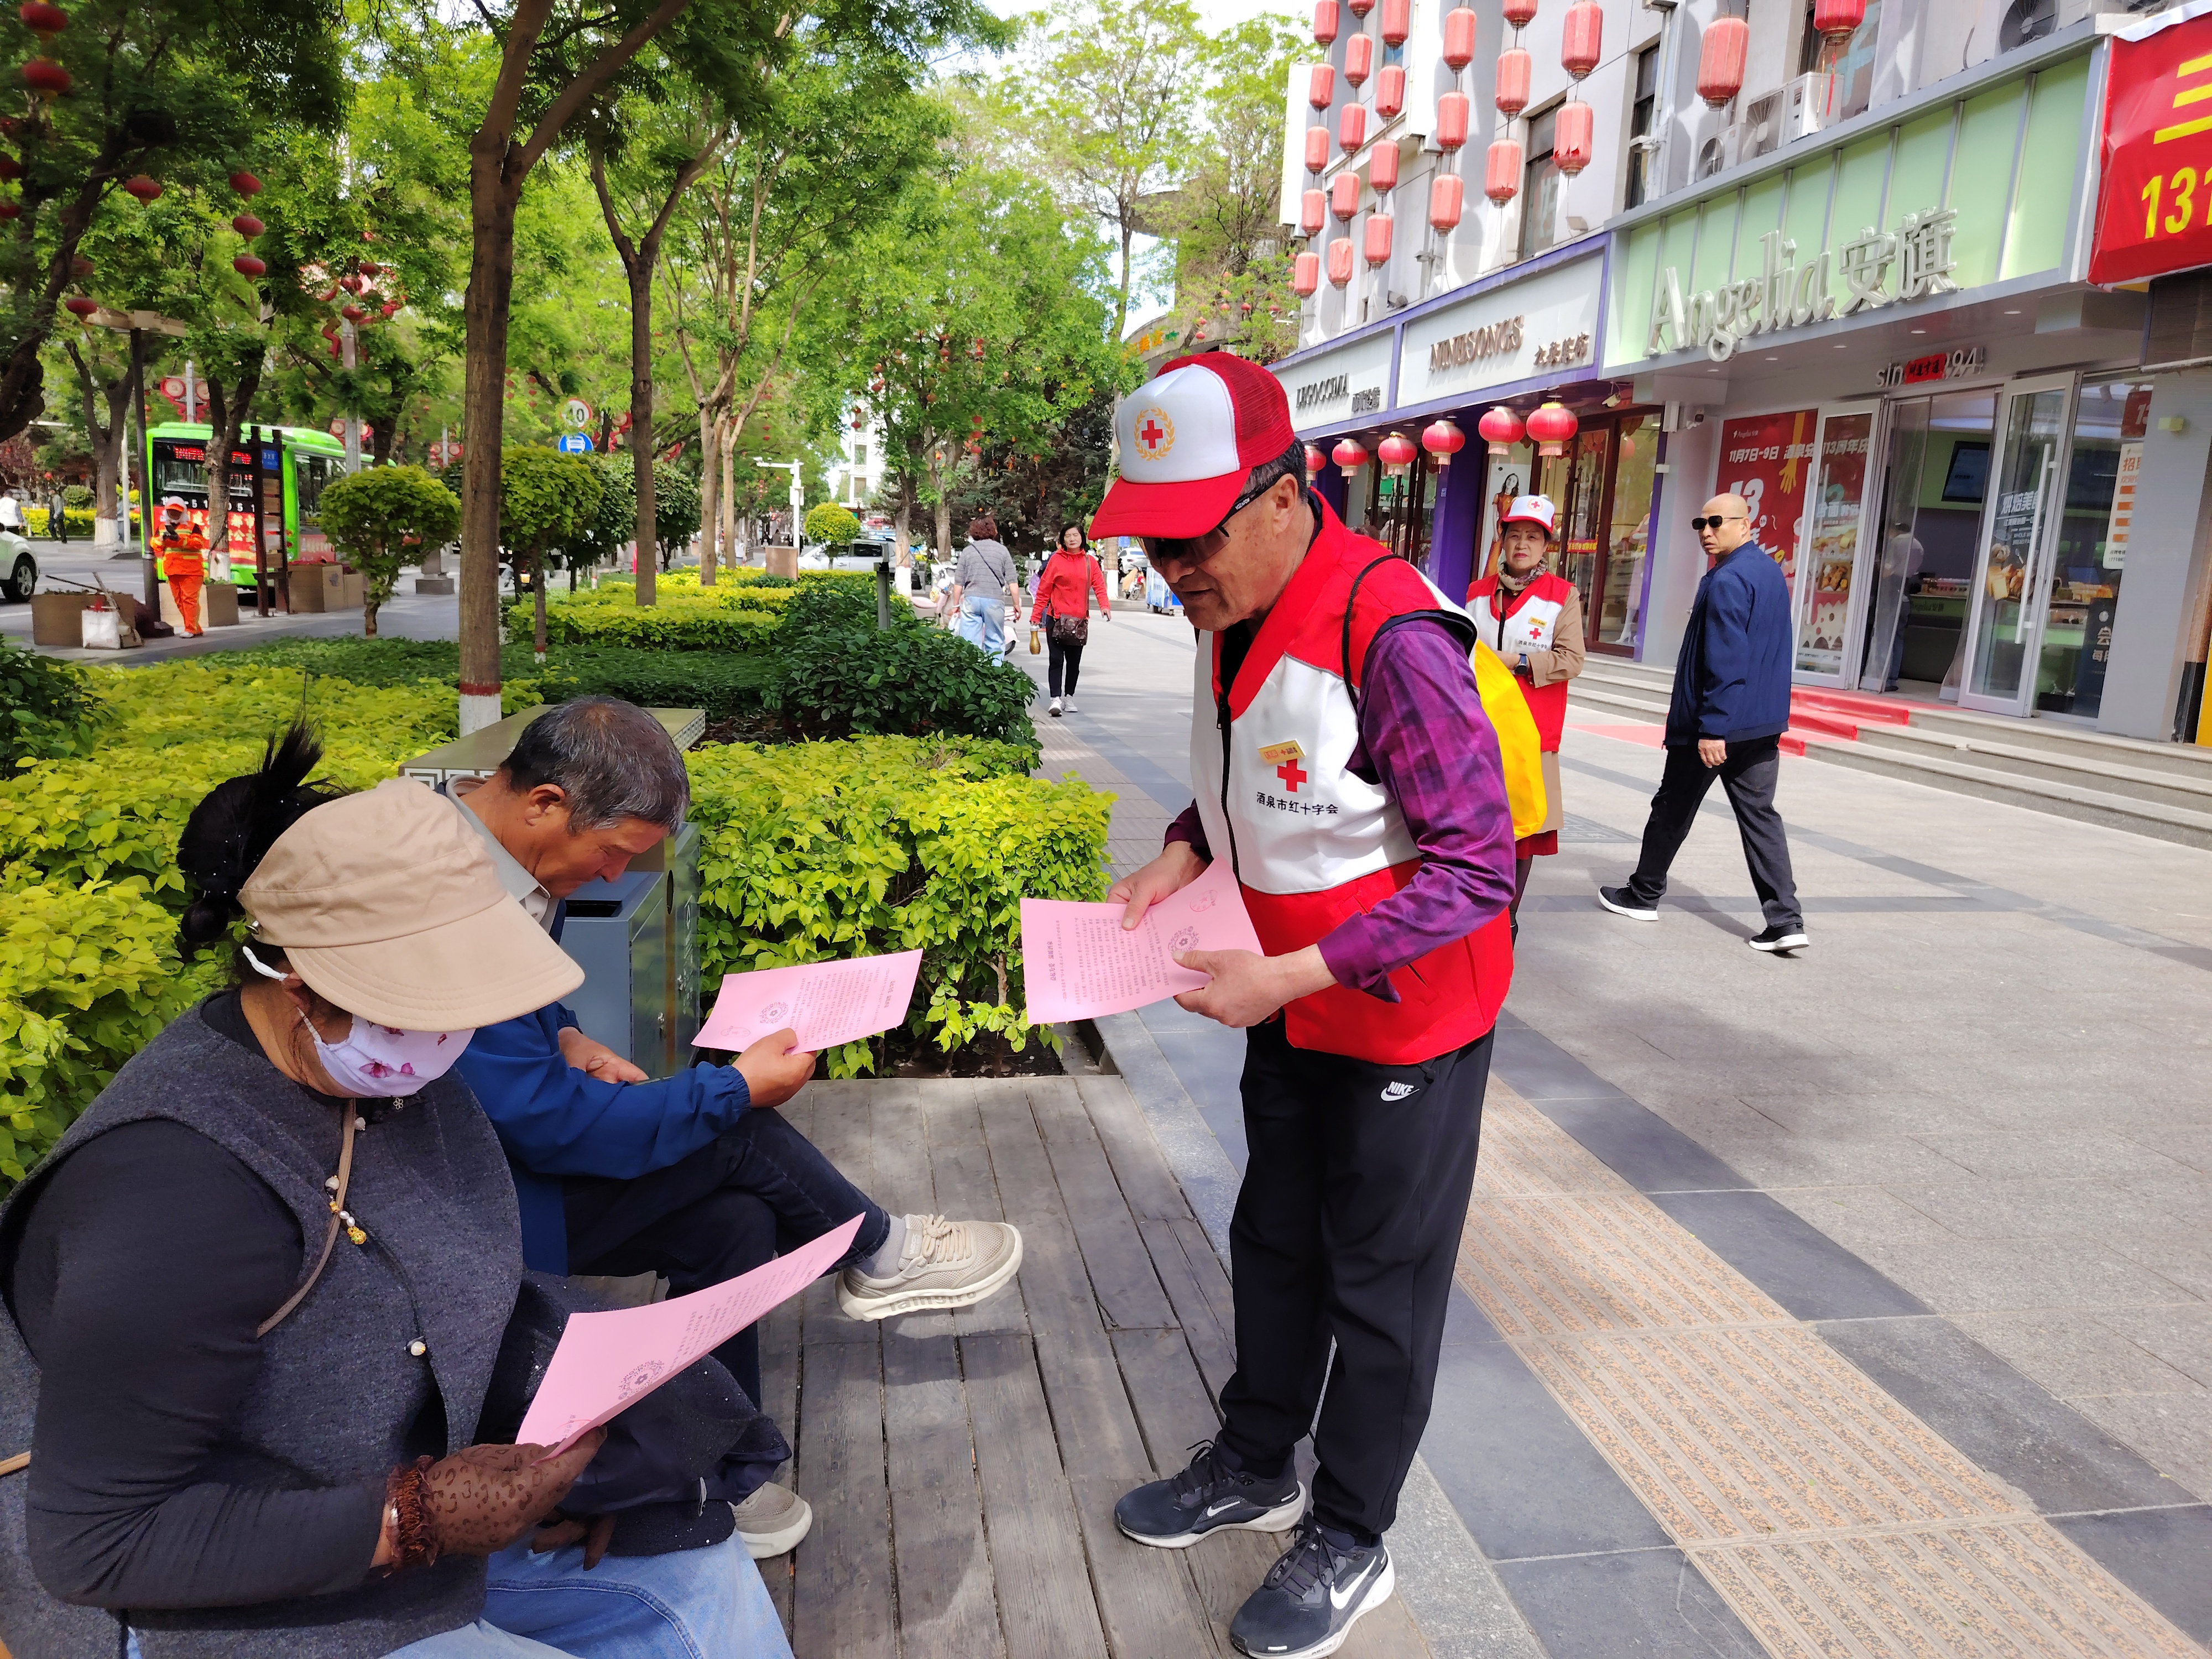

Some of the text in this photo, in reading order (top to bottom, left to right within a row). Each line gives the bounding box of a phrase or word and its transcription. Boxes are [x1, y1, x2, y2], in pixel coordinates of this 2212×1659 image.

[1642, 230, 1835, 362] Angelia
[1729, 446, 1779, 463] 11月7日-9日
[1256, 791, 1339, 815] 酒泉市红十字会
[1387, 1081, 1414, 1095] NIKE
